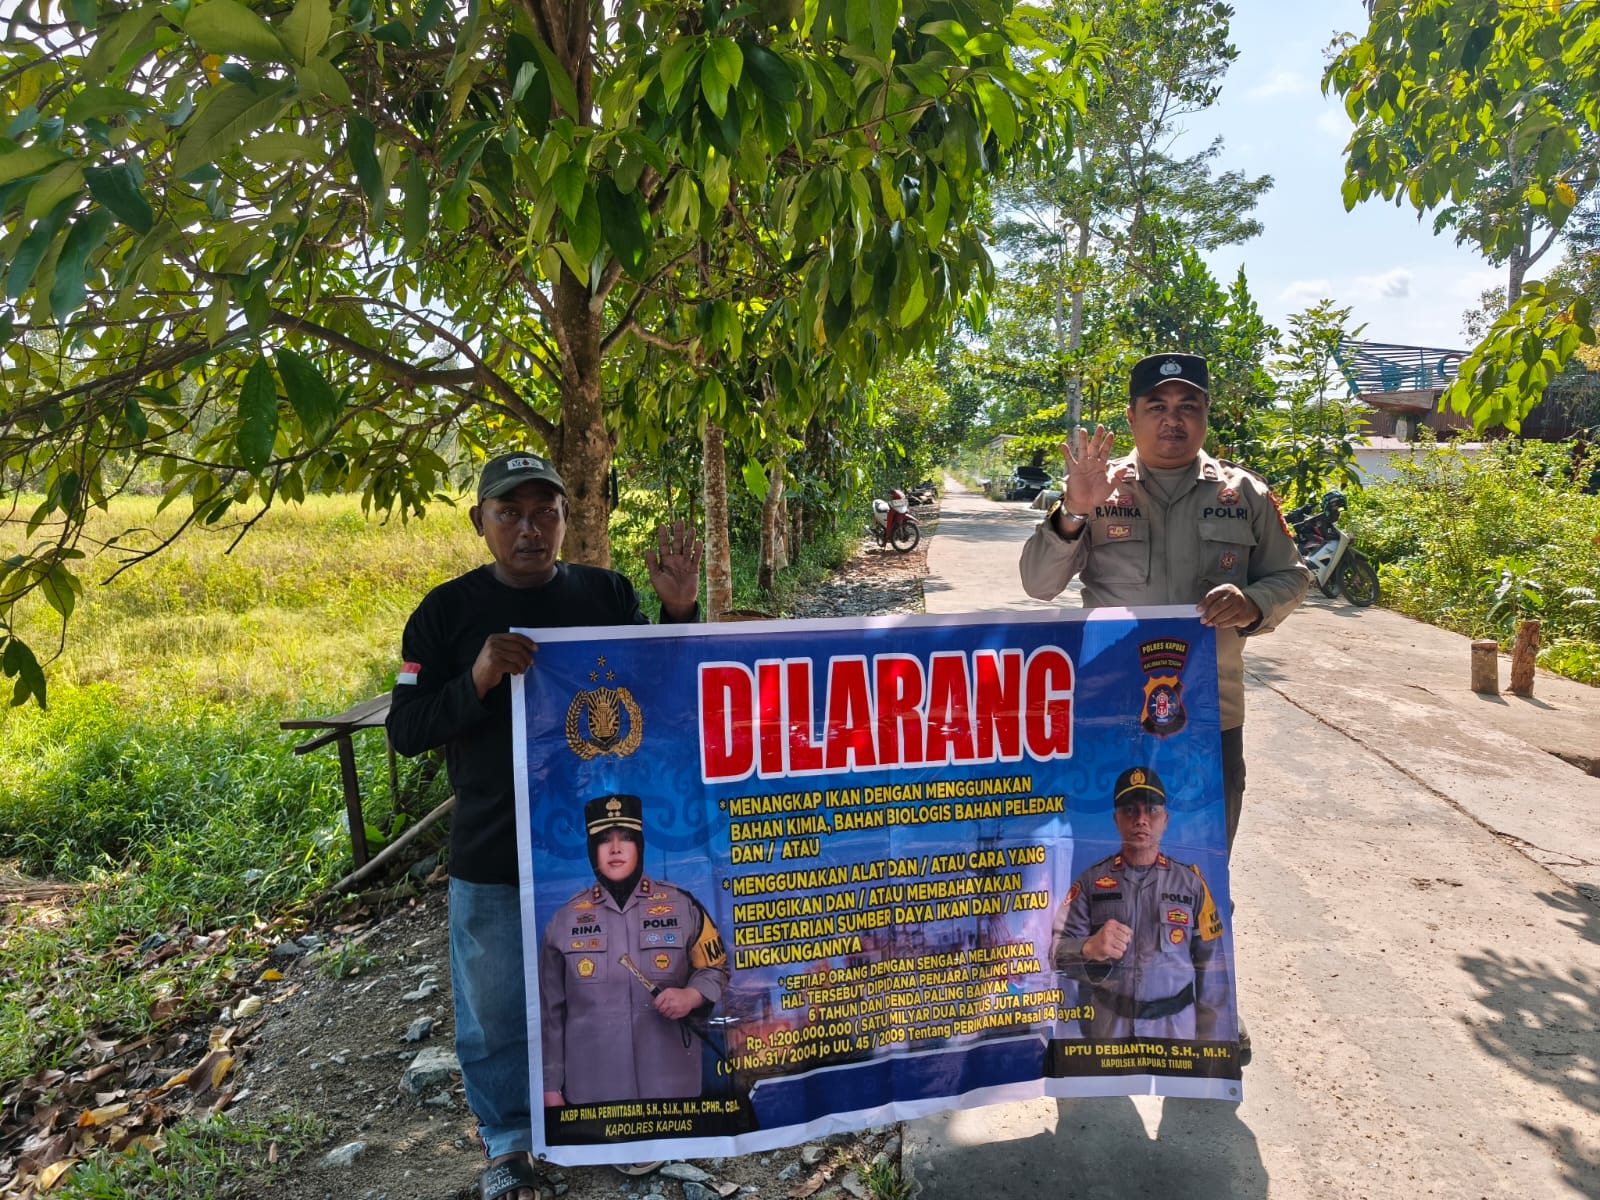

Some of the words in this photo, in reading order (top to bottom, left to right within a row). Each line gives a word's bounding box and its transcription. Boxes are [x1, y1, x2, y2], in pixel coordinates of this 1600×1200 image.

[1095, 505, 1141, 519] R.VATIKA
[1203, 507, 1248, 519] POLRI
[698, 645, 1075, 784] DILARANG
[729, 792, 822, 817] MENANGKAP
[826, 789, 860, 807] IKAN
[864, 784, 922, 804] DENGAN
[926, 777, 1031, 799] MENGGUNAKAN
[731, 820, 783, 841] BAHAN
[787, 816, 831, 835] KIMIA,
[834, 811, 884, 831] BAHAN
[887, 805, 951, 825] BIOLOGIS
[955, 801, 1001, 820] BAHAN
[1005, 797, 1064, 815] PELEDAK
[731, 844, 763, 864] DAN
[782, 839, 820, 859] ATAU
[733, 867, 848, 896] MENGGUNAKAN
[851, 861, 885, 882] ALAT
[888, 859, 917, 877] DAN
[930, 852, 966, 874] ATAU
[968, 849, 1006, 869] CARA
[1008, 846, 1046, 866] YANG
[733, 897, 823, 923] MERUGIKAN
[826, 890, 855, 913] DAN
[868, 885, 903, 906] ATAU
[906, 873, 1022, 901] MEMBAHAYAKAN
[1161, 893, 1193, 904] POLRI
[571, 925, 602, 936] RINA
[643, 918, 678, 929] POLRI
[735, 917, 834, 946] KELESTARIAN
[838, 909, 892, 932] SUMBER
[895, 905, 934, 925] DAYA
[937, 899, 969, 920] IKAN
[972, 896, 1001, 915] DAN
[1013, 891, 1049, 911] ATAU
[735, 935, 862, 969] LINGKUNGANNYA
[786, 973, 826, 991] SETIAP
[829, 967, 867, 984] ORANG
[870, 958, 914, 977] DENGAN
[917, 953, 966, 970] SENGAJA
[968, 942, 1034, 964] MELAKUKAN
[782, 994, 804, 1010] HAL
[807, 984, 865, 1005] TERSEBUT
[867, 975, 916, 995] DIPIDANA
[919, 969, 969, 985] PENJARA
[971, 962, 1008, 980] PALING
[1010, 959, 1041, 975] LAMA
[808, 1008, 816, 1022] 6
[819, 1003, 858, 1020] TAHUN
[860, 998, 883, 1015] DAN
[885, 992, 921, 1009] DENDA
[924, 986, 964, 1004] PALING
[966, 979, 1009, 999] BANYAK
[744, 1053, 764, 1070] No.
[766, 1051, 779, 1067] 31
[789, 1044, 817, 1063] 2004
[819, 1042, 830, 1058] jo
[833, 1038, 853, 1053] UU.
[855, 1035, 870, 1050] 45
[879, 1028, 905, 1046] 2009
[908, 1024, 951, 1042] Tentang
[953, 1013, 1013, 1035] PERIKANAN
[1014, 1009, 1042, 1024] Pasal
[1042, 1008, 1055, 1021] 84
[1057, 1006, 1081, 1022] ayat
[1083, 1005, 1095, 1021] 2)
[746, 1036, 766, 1052] Rp.
[768, 1021, 851, 1047] 1.200.000.000
[890, 1008, 930, 1026] MILYAR
[932, 1003, 957, 1019] DUA
[959, 998, 991, 1016] RATUS
[993, 995, 1020, 1011] JUTA
[1023, 990, 1065, 1007] RUPIAH)
[1064, 1045, 1092, 1056] IPTU
[1095, 1043, 1168, 1057] DEBIANTHO,
[1171, 1045, 1200, 1059] S.H.,
[1203, 1047, 1231, 1058] M.H.
[1101, 1058, 1136, 1068] KAPOLSEK
[1137, 1058, 1167, 1068] KAPUAS
[1168, 1059, 1193, 1070] TIMUR
[560, 1109, 579, 1122] AKBP
[580, 1107, 597, 1120] RINA
[599, 1103, 645, 1119] PERWITASARI,
[605, 1121, 654, 1137] KAPOLRES
[656, 1119, 693, 1133] KAPUAS
